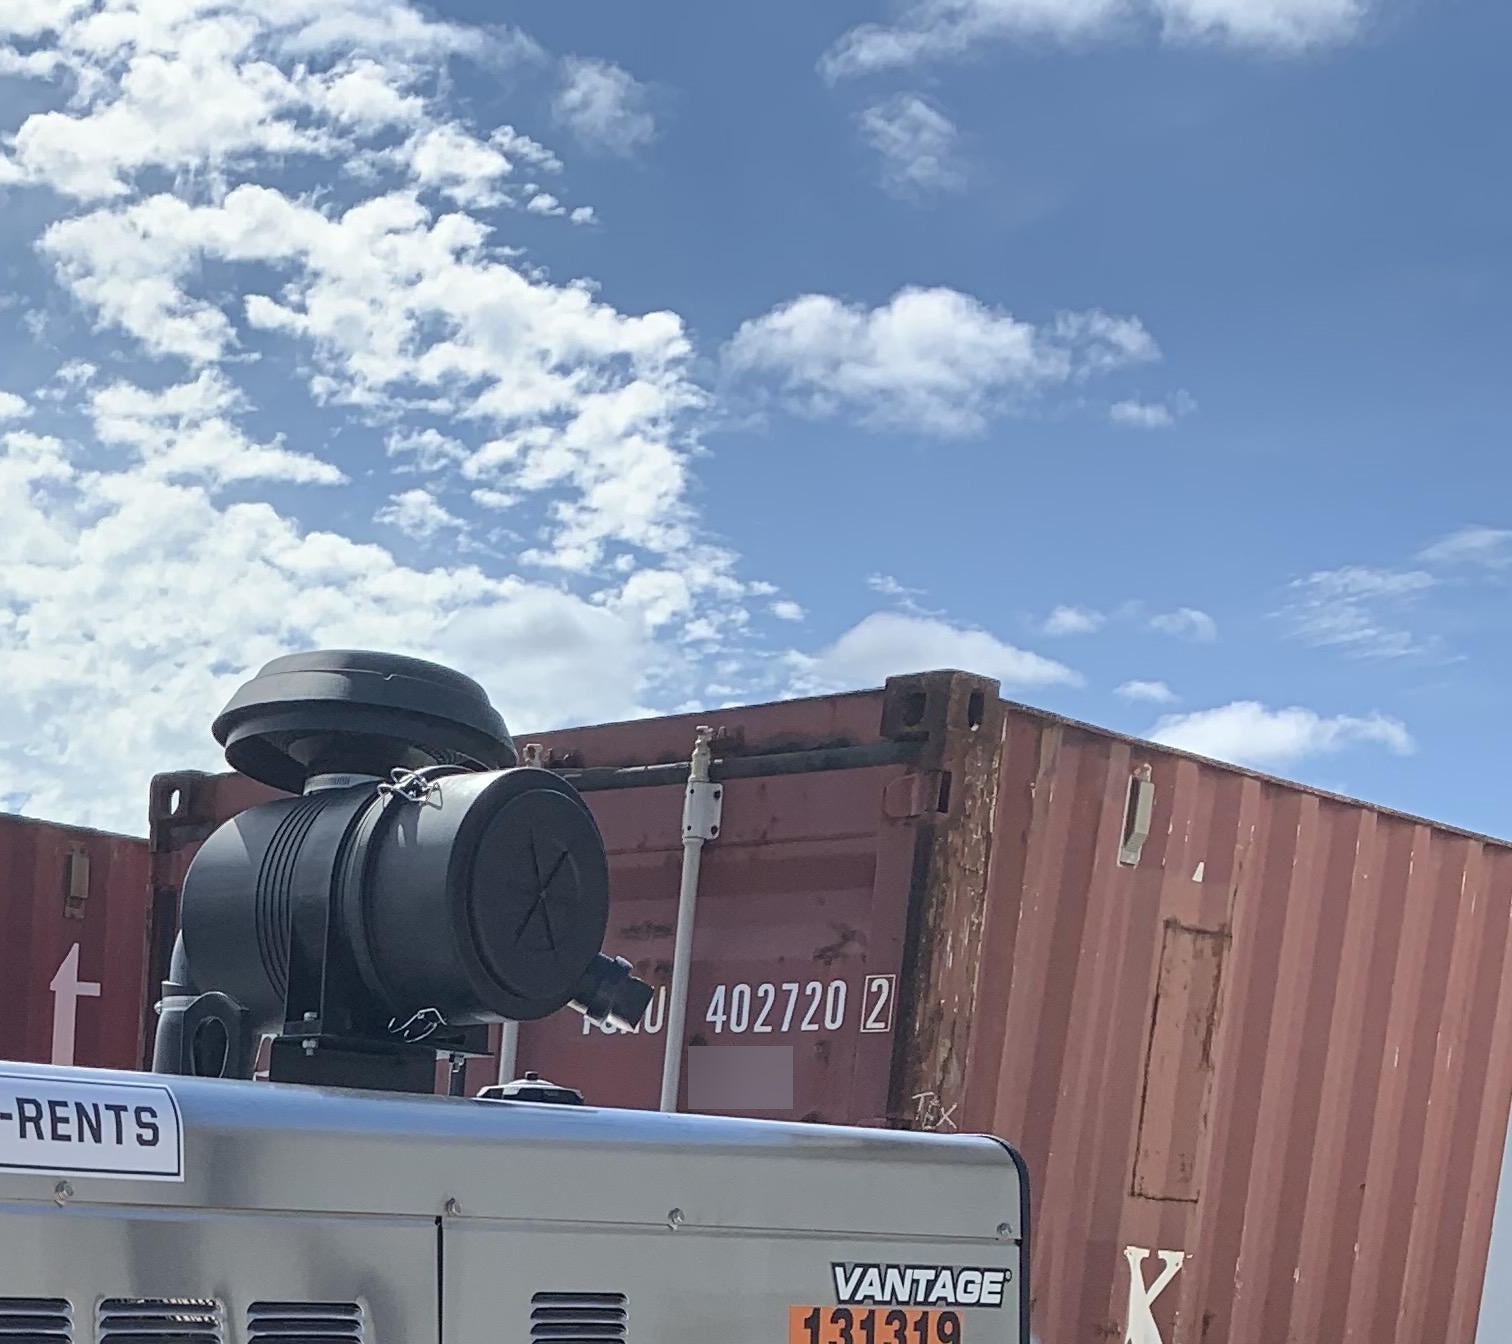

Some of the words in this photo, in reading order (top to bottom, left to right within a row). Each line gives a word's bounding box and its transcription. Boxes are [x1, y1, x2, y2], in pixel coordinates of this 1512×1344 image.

[705, 979, 848, 1034] 402720
[864, 977, 892, 1030] 2
[833, 1266, 1008, 1307] VANTAGE
